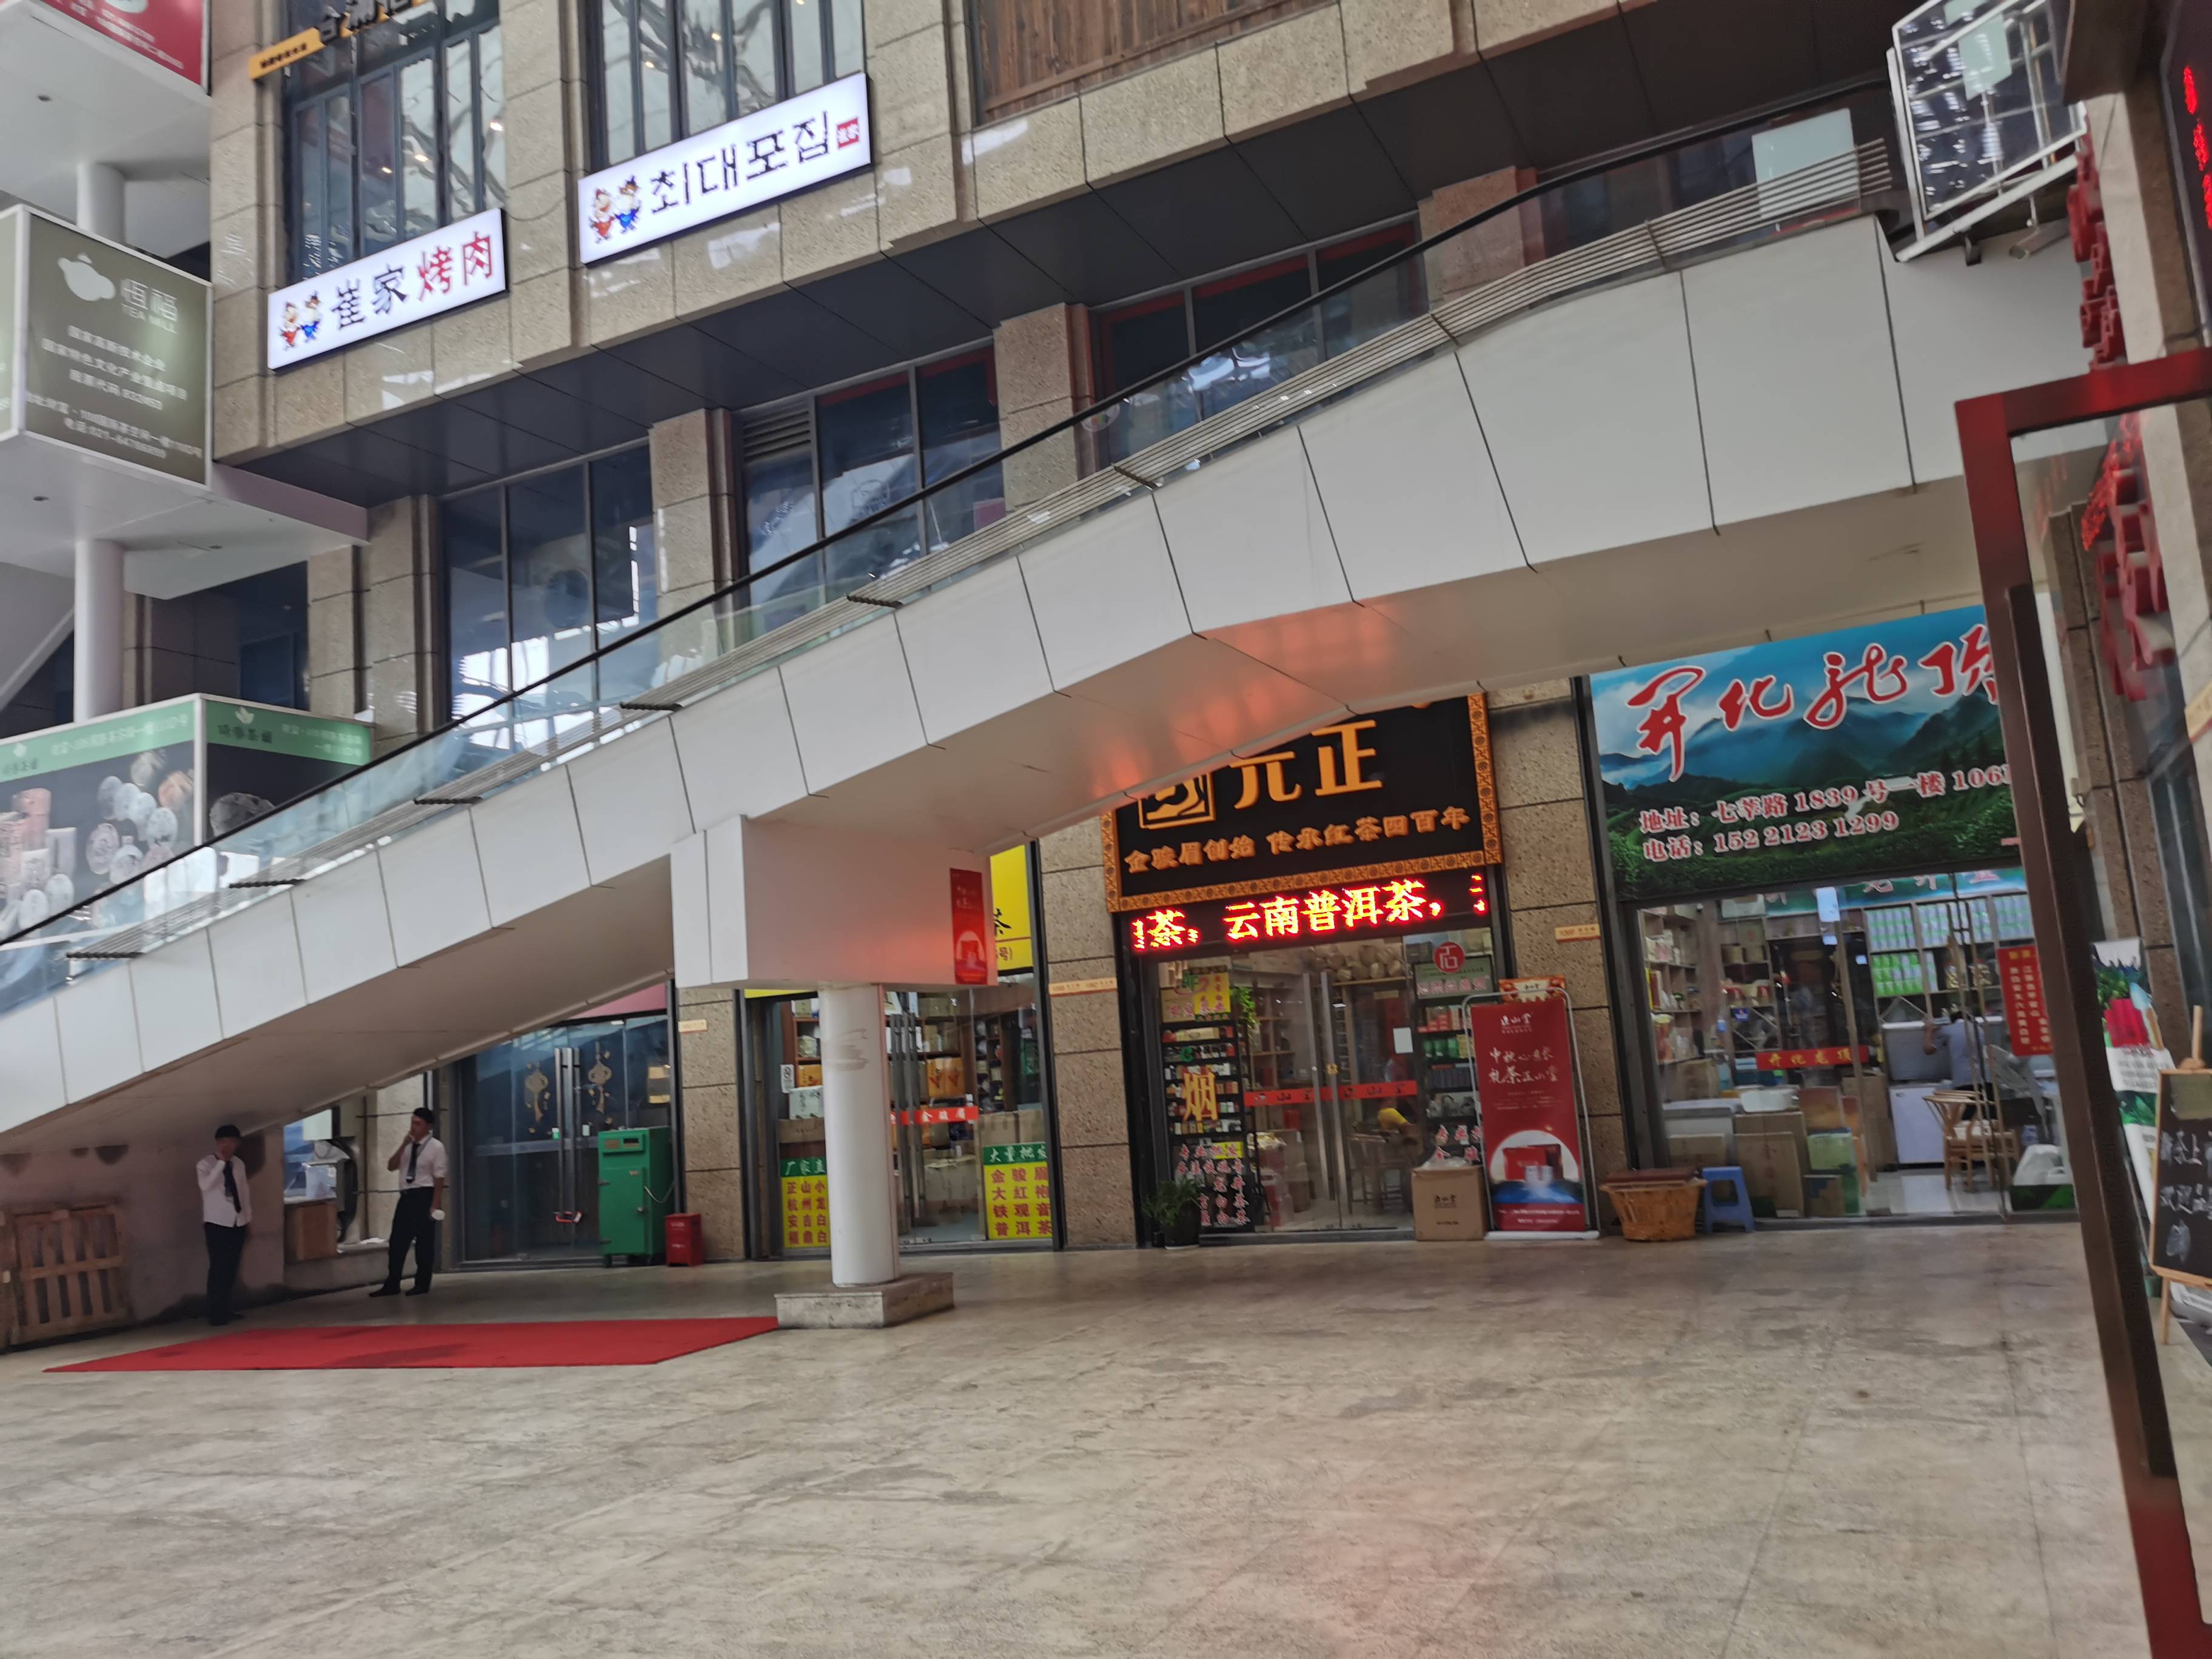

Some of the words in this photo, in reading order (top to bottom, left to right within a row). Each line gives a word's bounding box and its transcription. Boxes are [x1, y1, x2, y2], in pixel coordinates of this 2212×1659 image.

[651, 110, 830, 213] 최대포집
[332, 231, 492, 329] 崔家烤肉
[1228, 719, 1383, 809] 元正
[1794, 785, 1858, 813] 1839
[1124, 834, 1256, 874] 金骏眉创始
[1265, 805, 1470, 856] 传承红茶四百年
[1713, 829, 1759, 853] 152
[1763, 820, 1829, 846] 2123
[1833, 810, 1900, 836] 1299
[1183, 1071, 1219, 1122] 烟
[992, 1185, 1049, 1201] 大红袍
[993, 1202, 1051, 1218] 铁观音
[994, 1219, 1052, 1236] 普洱茶
